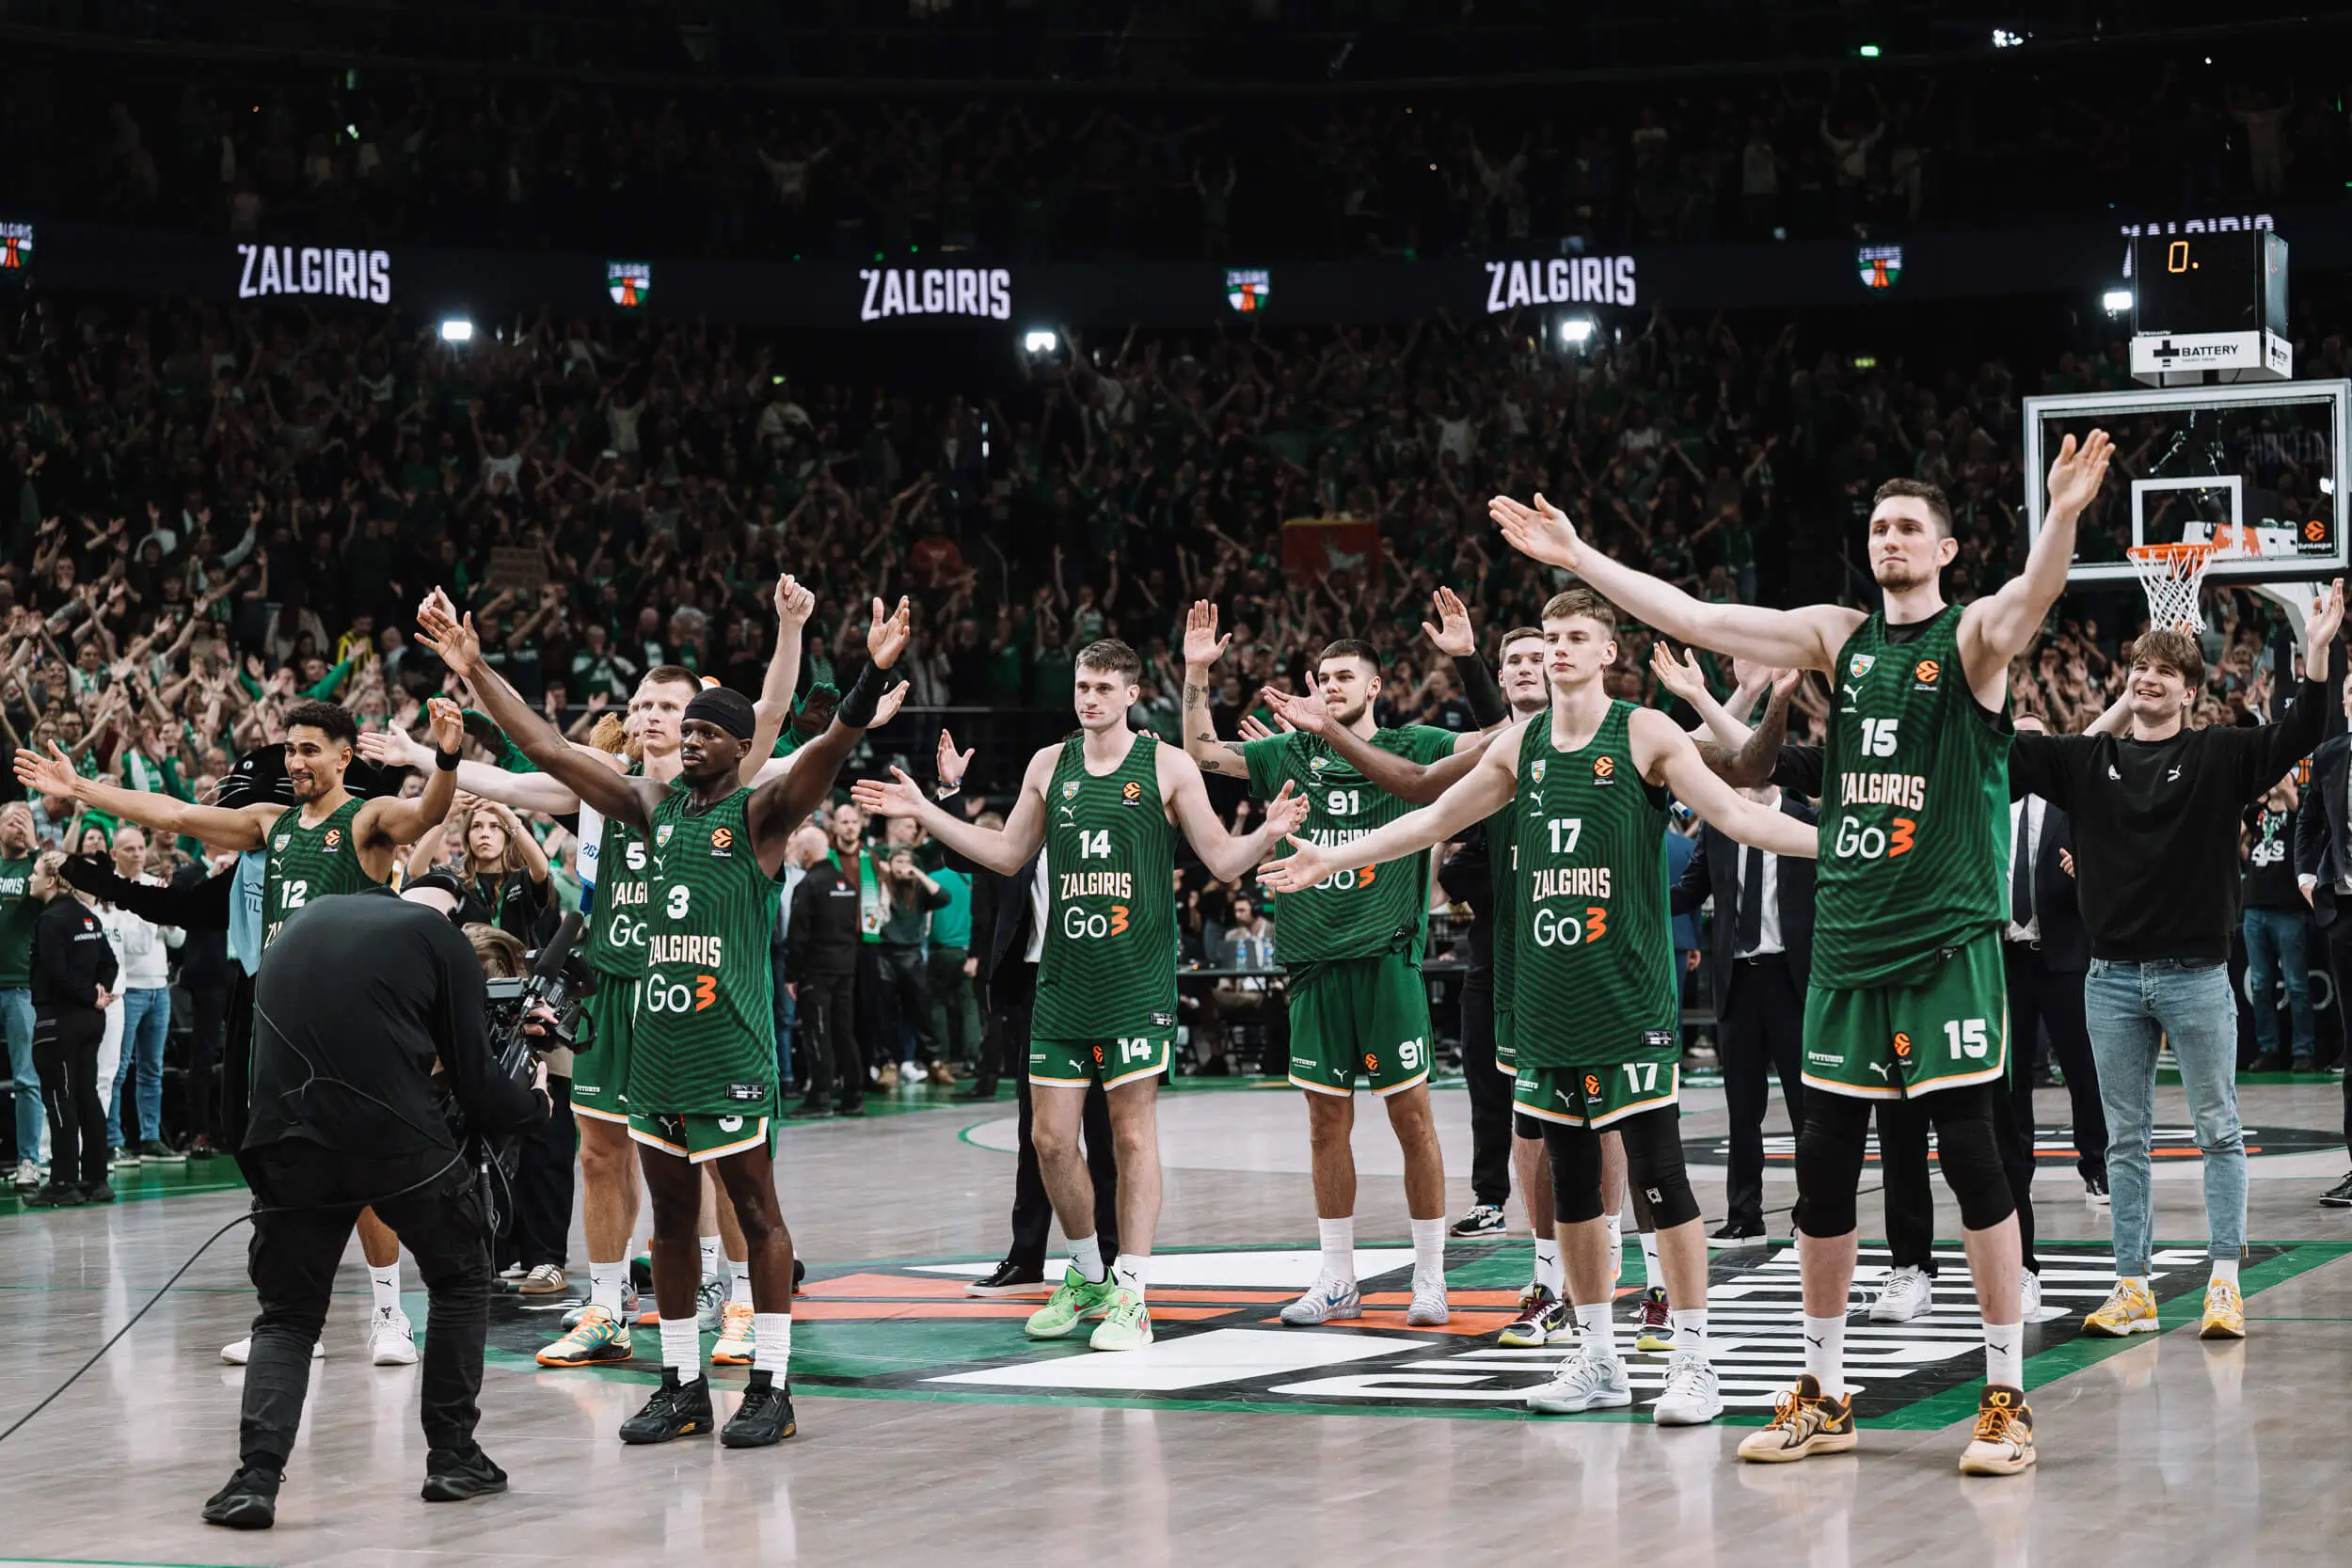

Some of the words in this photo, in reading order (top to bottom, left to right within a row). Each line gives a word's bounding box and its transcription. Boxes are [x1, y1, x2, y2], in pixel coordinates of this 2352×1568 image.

[2182, 344, 2239, 356] BATTERY
[1861, 718, 1899, 757] 15
[1327, 789, 1359, 816] 91
[1079, 829, 1111, 859] 14
[1548, 818, 1581, 853] 17
[626, 841, 647, 870] 5
[281, 879, 308, 910] 12
[667, 885, 690, 919] 3
[1117, 1037, 1152, 1064] 14
[1398, 1037, 1425, 1070] 91
[1944, 1018, 1988, 1060] 15
[1622, 1062, 1659, 1094] 17
